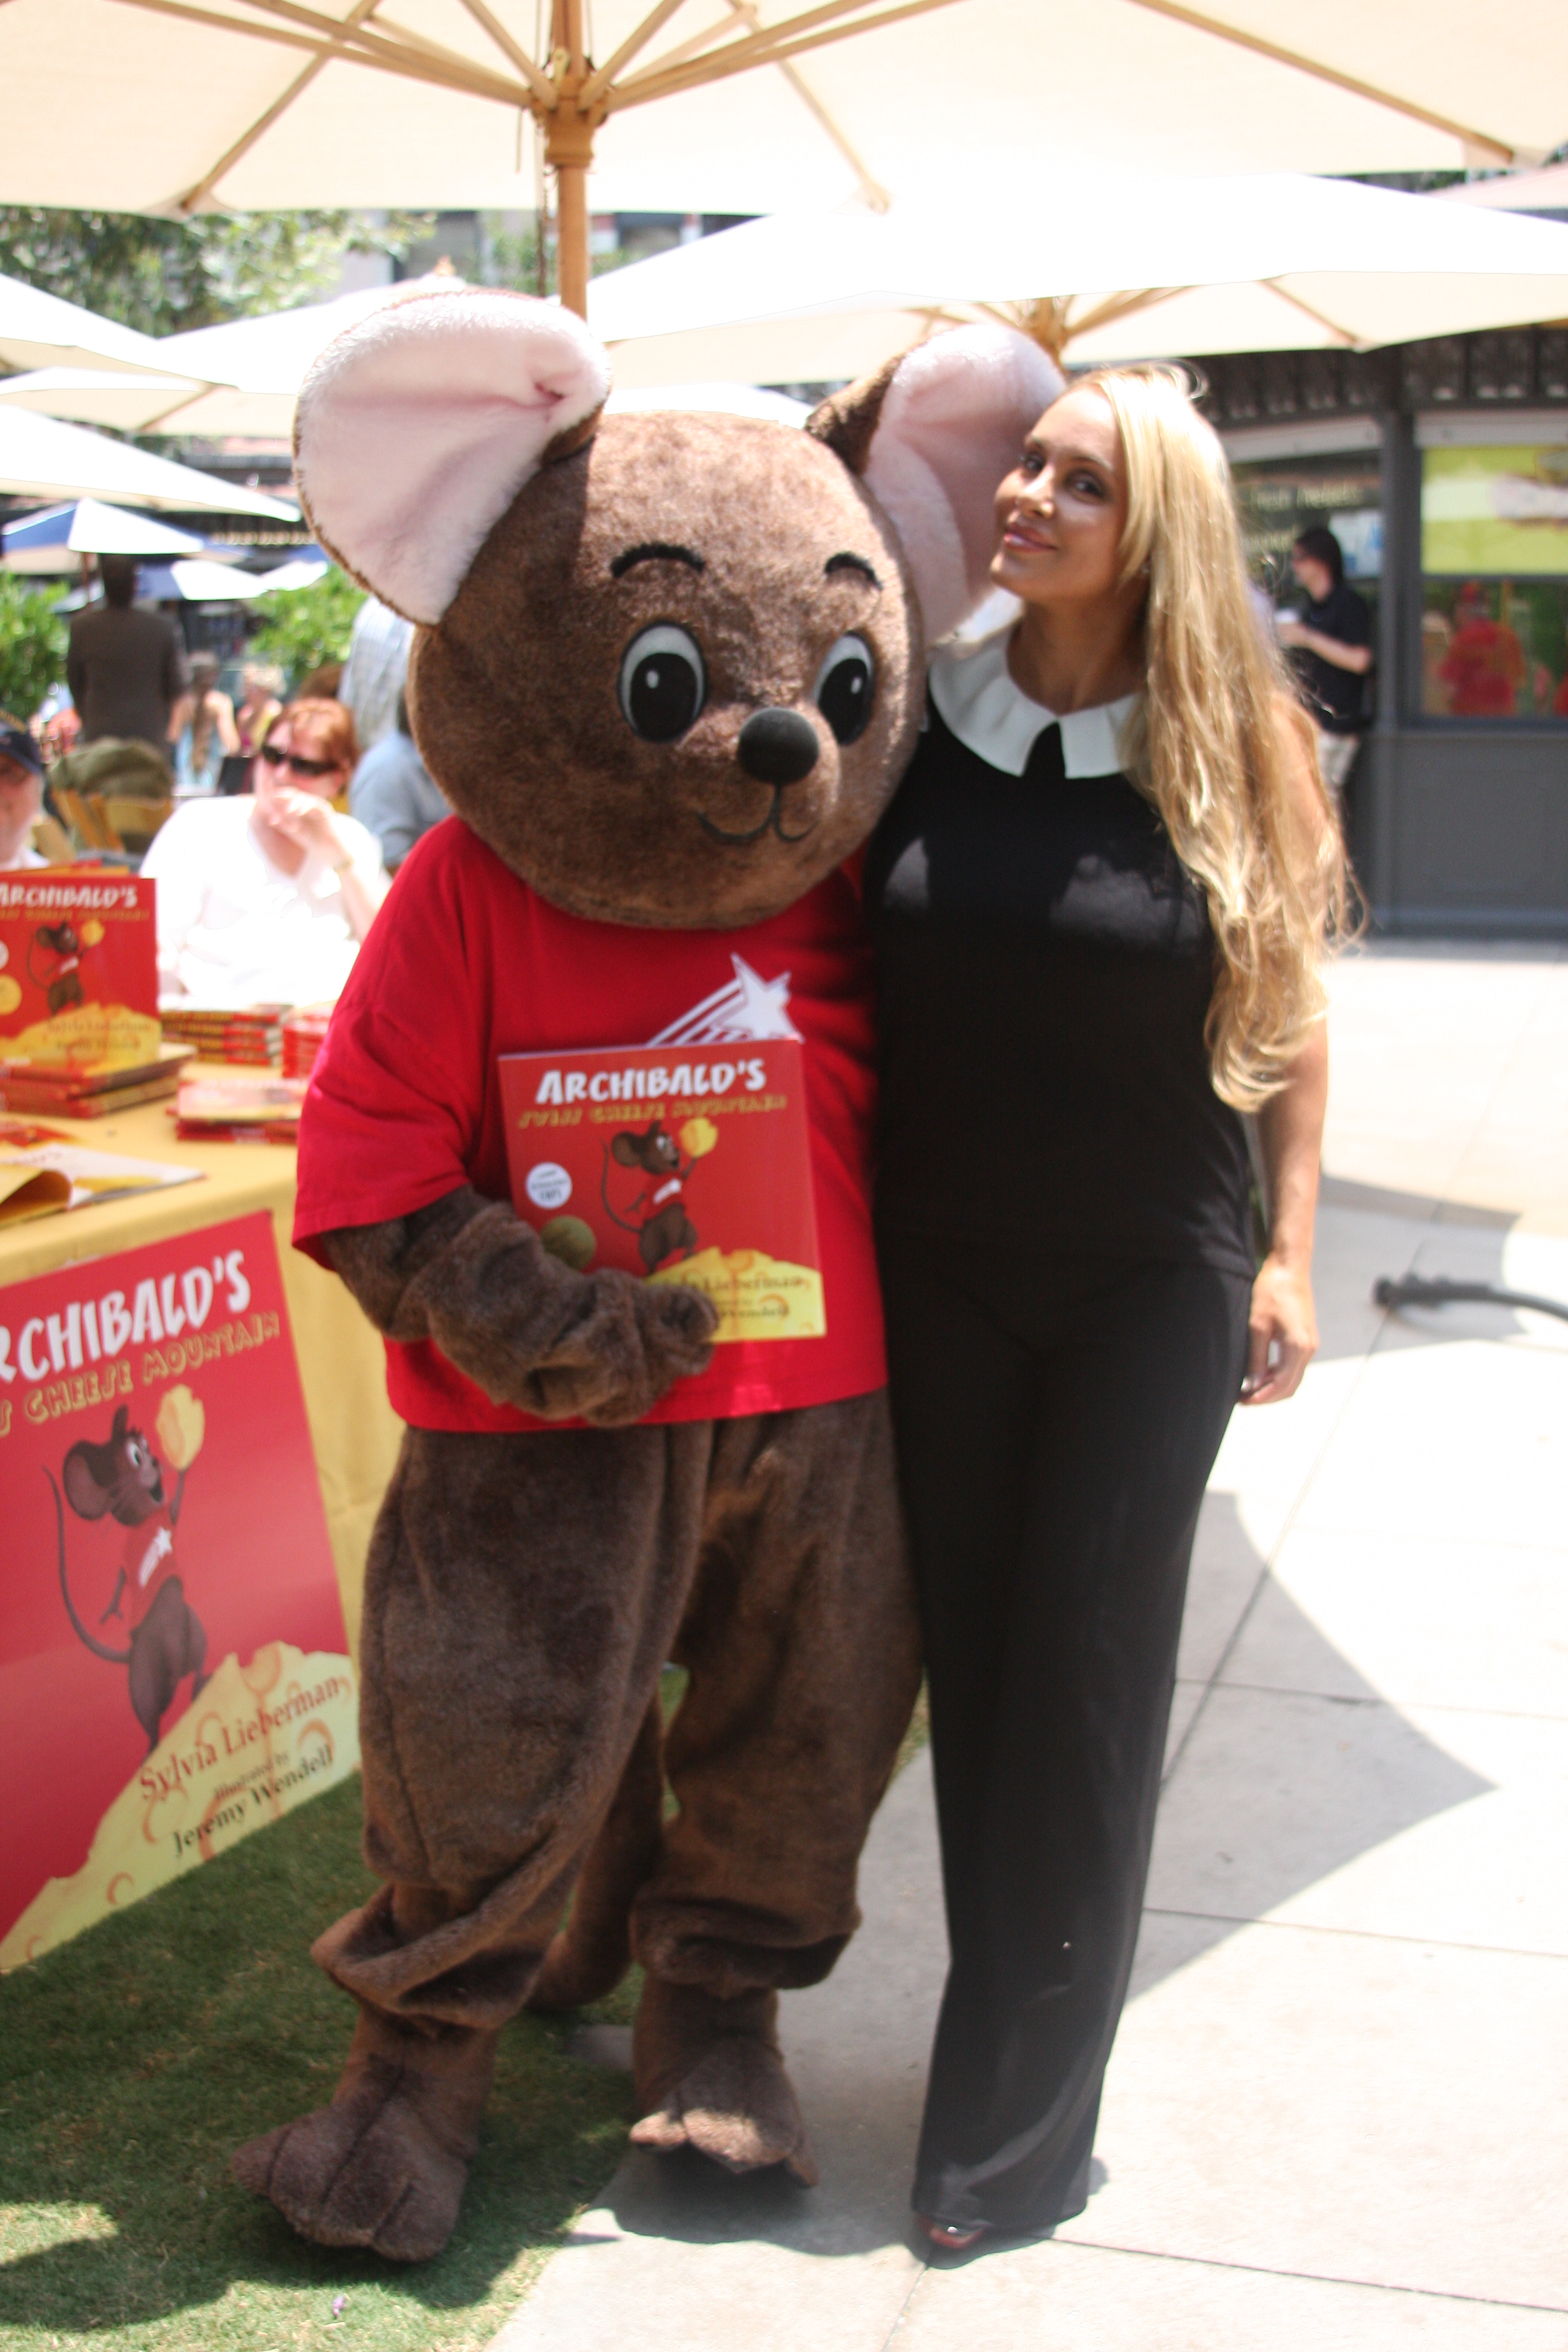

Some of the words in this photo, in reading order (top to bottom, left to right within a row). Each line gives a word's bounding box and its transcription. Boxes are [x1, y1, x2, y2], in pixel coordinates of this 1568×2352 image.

[535, 1057, 767, 1106] ARCHIBALD'S
[24, 1358, 134, 1425] CHEESE
[141, 1310, 280, 1386] MOUNTAIN
[140, 1741, 218, 1802] Sylvia
[221, 1676, 339, 1756] Lieberman
[174, 1802, 245, 1857] Jeremy
[250, 1743, 333, 1805] Wendell
